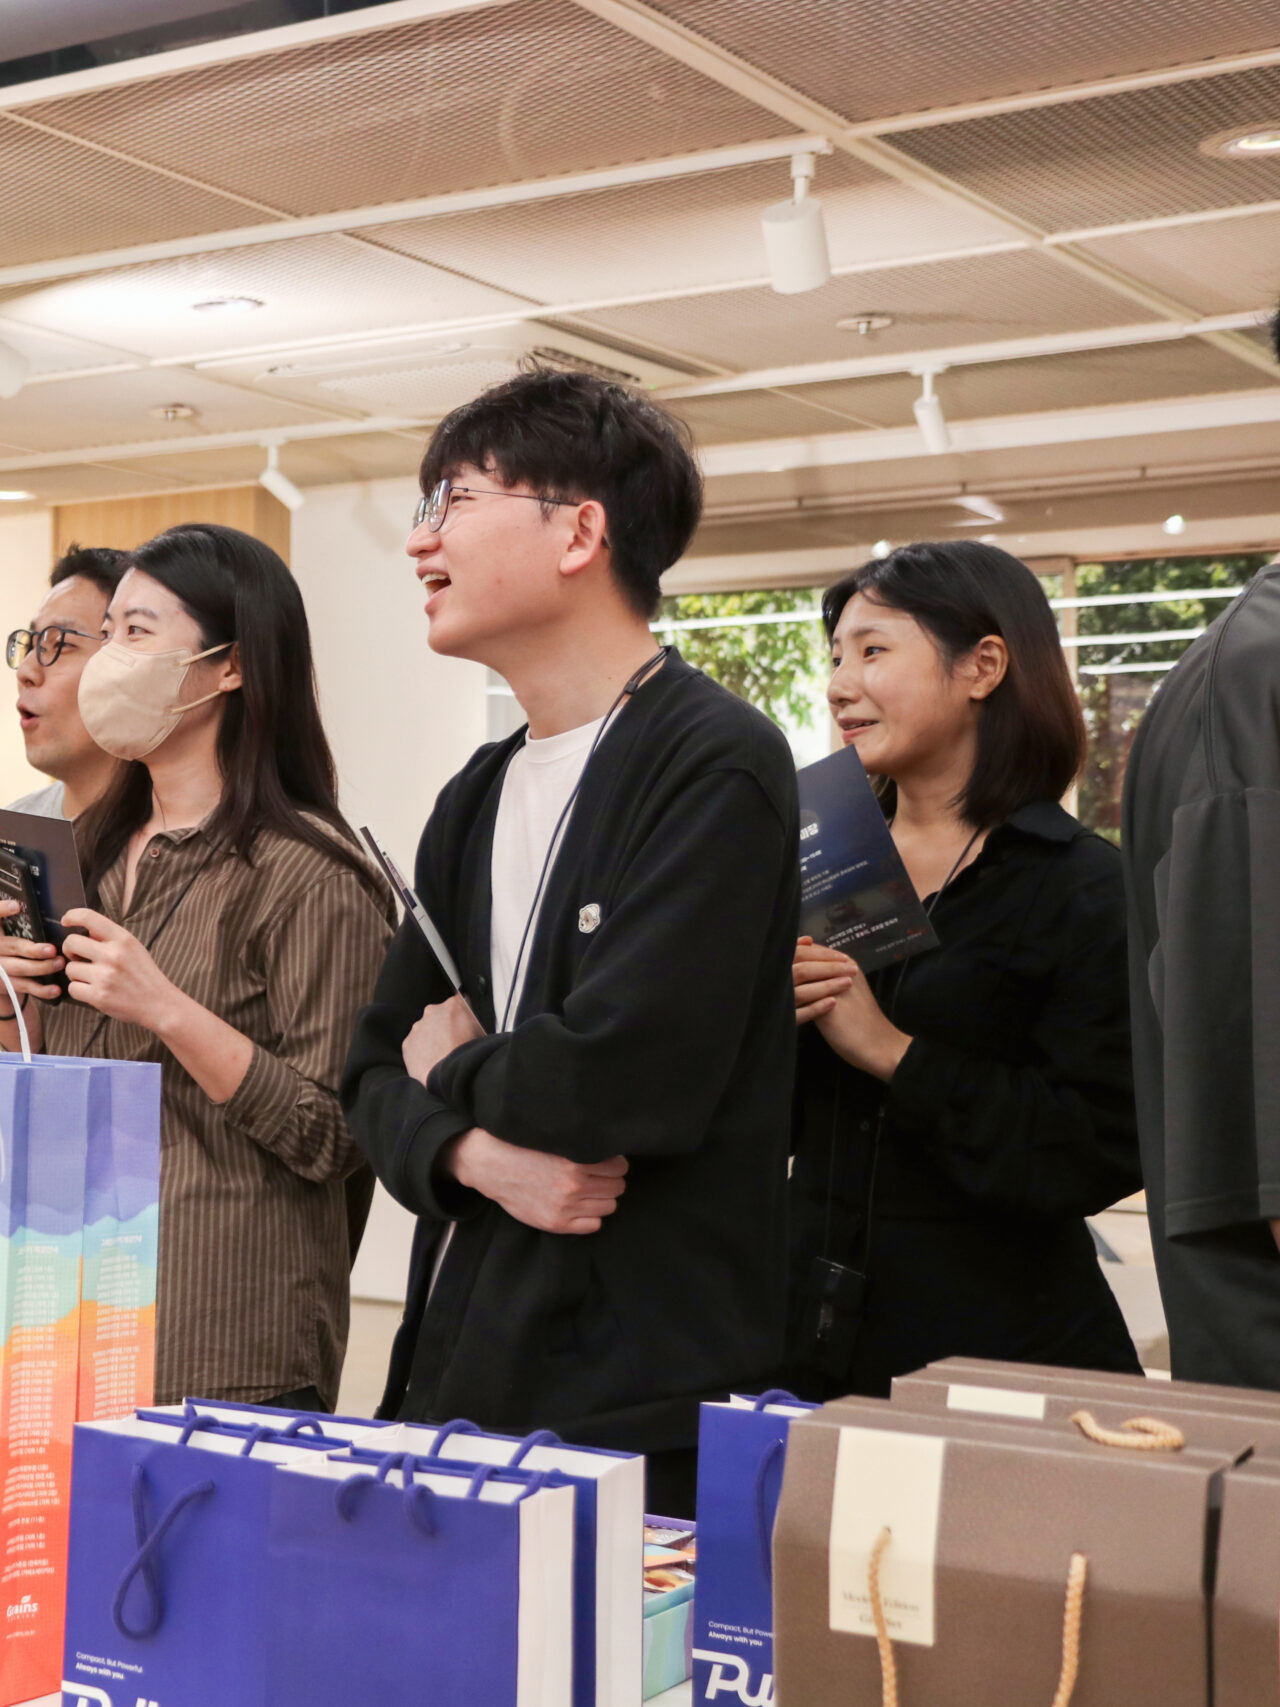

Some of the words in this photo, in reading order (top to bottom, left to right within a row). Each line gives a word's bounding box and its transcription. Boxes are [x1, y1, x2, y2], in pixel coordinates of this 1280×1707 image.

[6, 1595, 39, 1617] Grains
[742, 1625, 754, 1635] But
[708, 1631, 732, 1642] Always
[733, 1636, 749, 1644] with
[749, 1638, 763, 1647] you
[75, 1662, 98, 1674] Always
[98, 1667, 112, 1676] with
[106, 1658, 117, 1667] But
